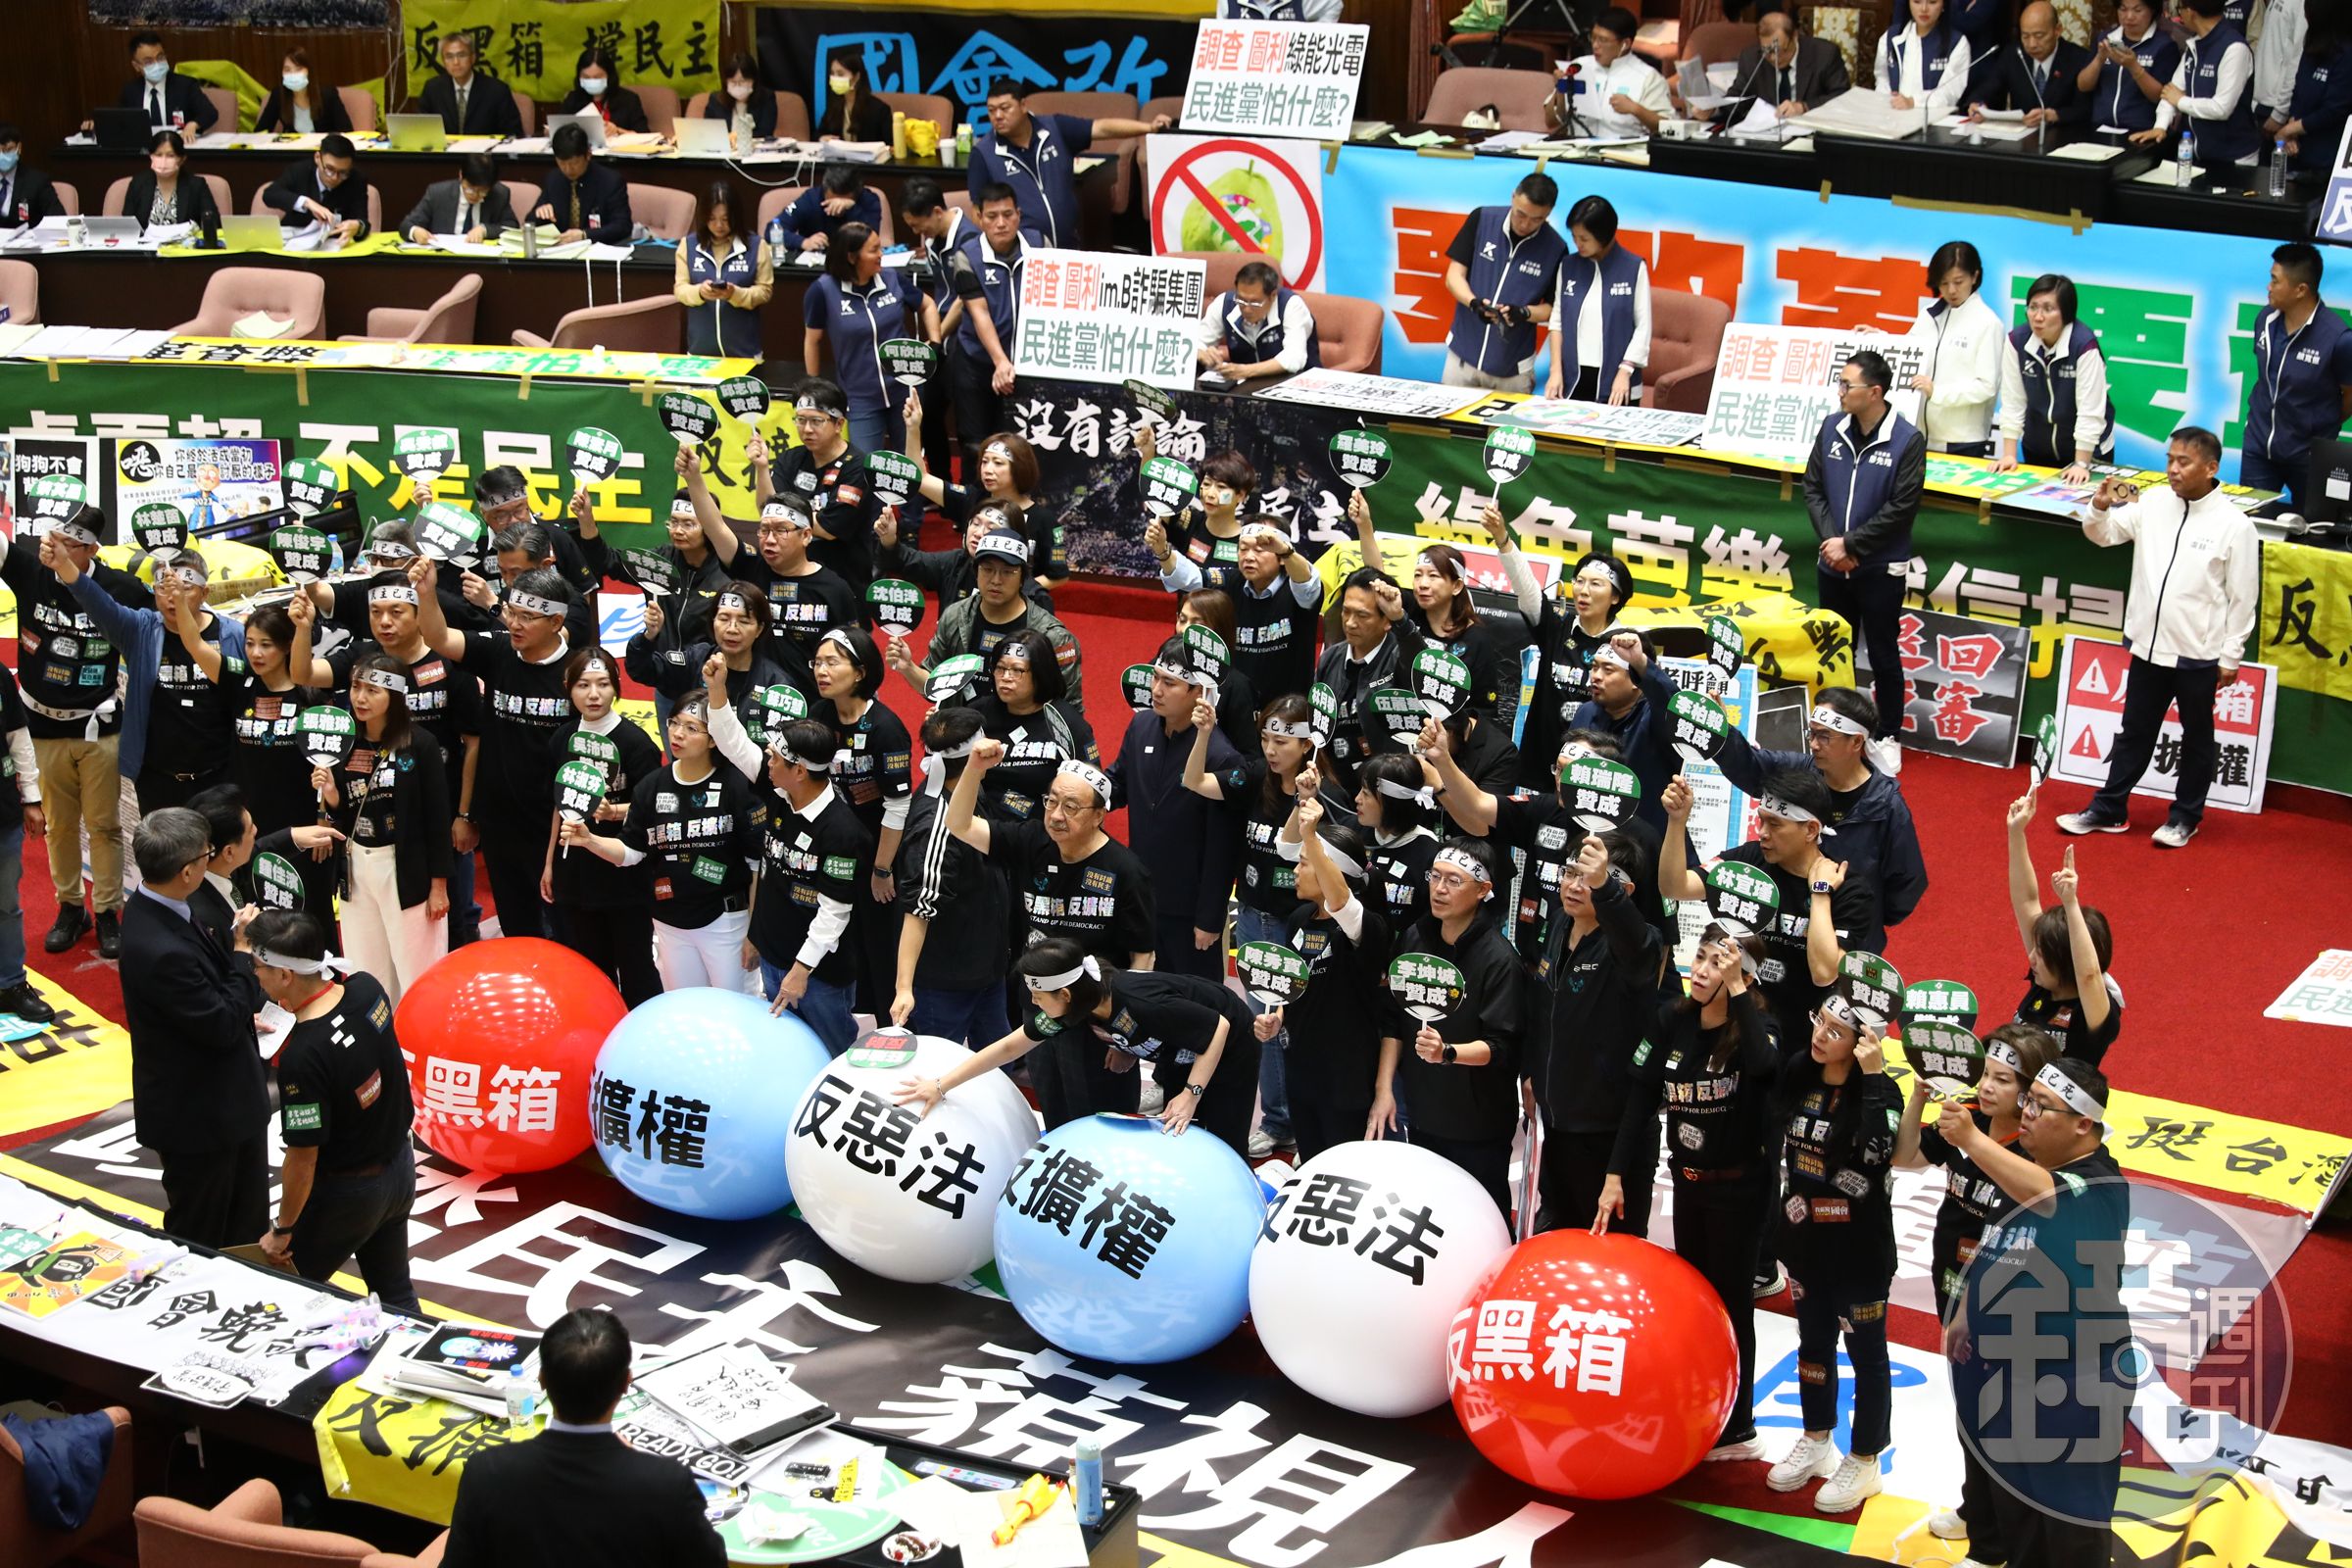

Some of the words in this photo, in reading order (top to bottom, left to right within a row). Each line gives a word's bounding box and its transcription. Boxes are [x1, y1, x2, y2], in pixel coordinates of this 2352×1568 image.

[1196, 27, 1244, 72] 調查
[1246, 30, 1365, 77] 圖利綠能光電
[1184, 80, 1350, 128] 民進黨怕什麼?
[1024, 258, 1061, 309] 調查
[1019, 318, 1193, 378] 民進黨怕什麼?
[1721, 334, 1778, 382] 調查
[891, 358, 929, 376] 贊成
[670, 412, 706, 435] 贊成
[15, 454, 83, 476] 狗狗不會
[174, 445, 253, 464] 你終於活成當初
[869, 453, 919, 481] 陳培瑜
[1341, 453, 1379, 476] 贊成
[874, 473, 910, 497] 贊成
[1148, 480, 1183, 508] 贊成
[283, 550, 321, 572] 贊成
[871, 585, 920, 606] 沈伯洋
[784, 604, 829, 622] 反擴權
[878, 603, 914, 625] 贊成
[1420, 674, 1457, 707] 贊成
[306, 731, 343, 755] 贊成
[1674, 717, 1712, 752] 贊成
[1010, 741, 1058, 760] 反擴權
[561, 767, 605, 794] 林淑芬
[1569, 763, 1635, 796] 賴瑞隆
[562, 787, 593, 813] 贊成
[1574, 788, 1623, 818] 贊成
[687, 814, 734, 840] 反擴權
[1714, 865, 1775, 904] 林宜瑾
[1067, 896, 1116, 918] 反擴權
[1718, 890, 1761, 926] 贊成
[1249, 968, 1292, 995] 贊成
[1396, 958, 1458, 988] 李坤城
[1403, 981, 1449, 1008] 贊成
[1851, 980, 1891, 1014] 贊成
[1904, 989, 1972, 1012] 賴惠員
[1907, 1027, 1978, 1055] 蔡易餘
[1920, 1051, 1972, 1080] 贊成
[793, 1073, 987, 1221] 反惡法
[695, 1453, 747, 1479] GO!
